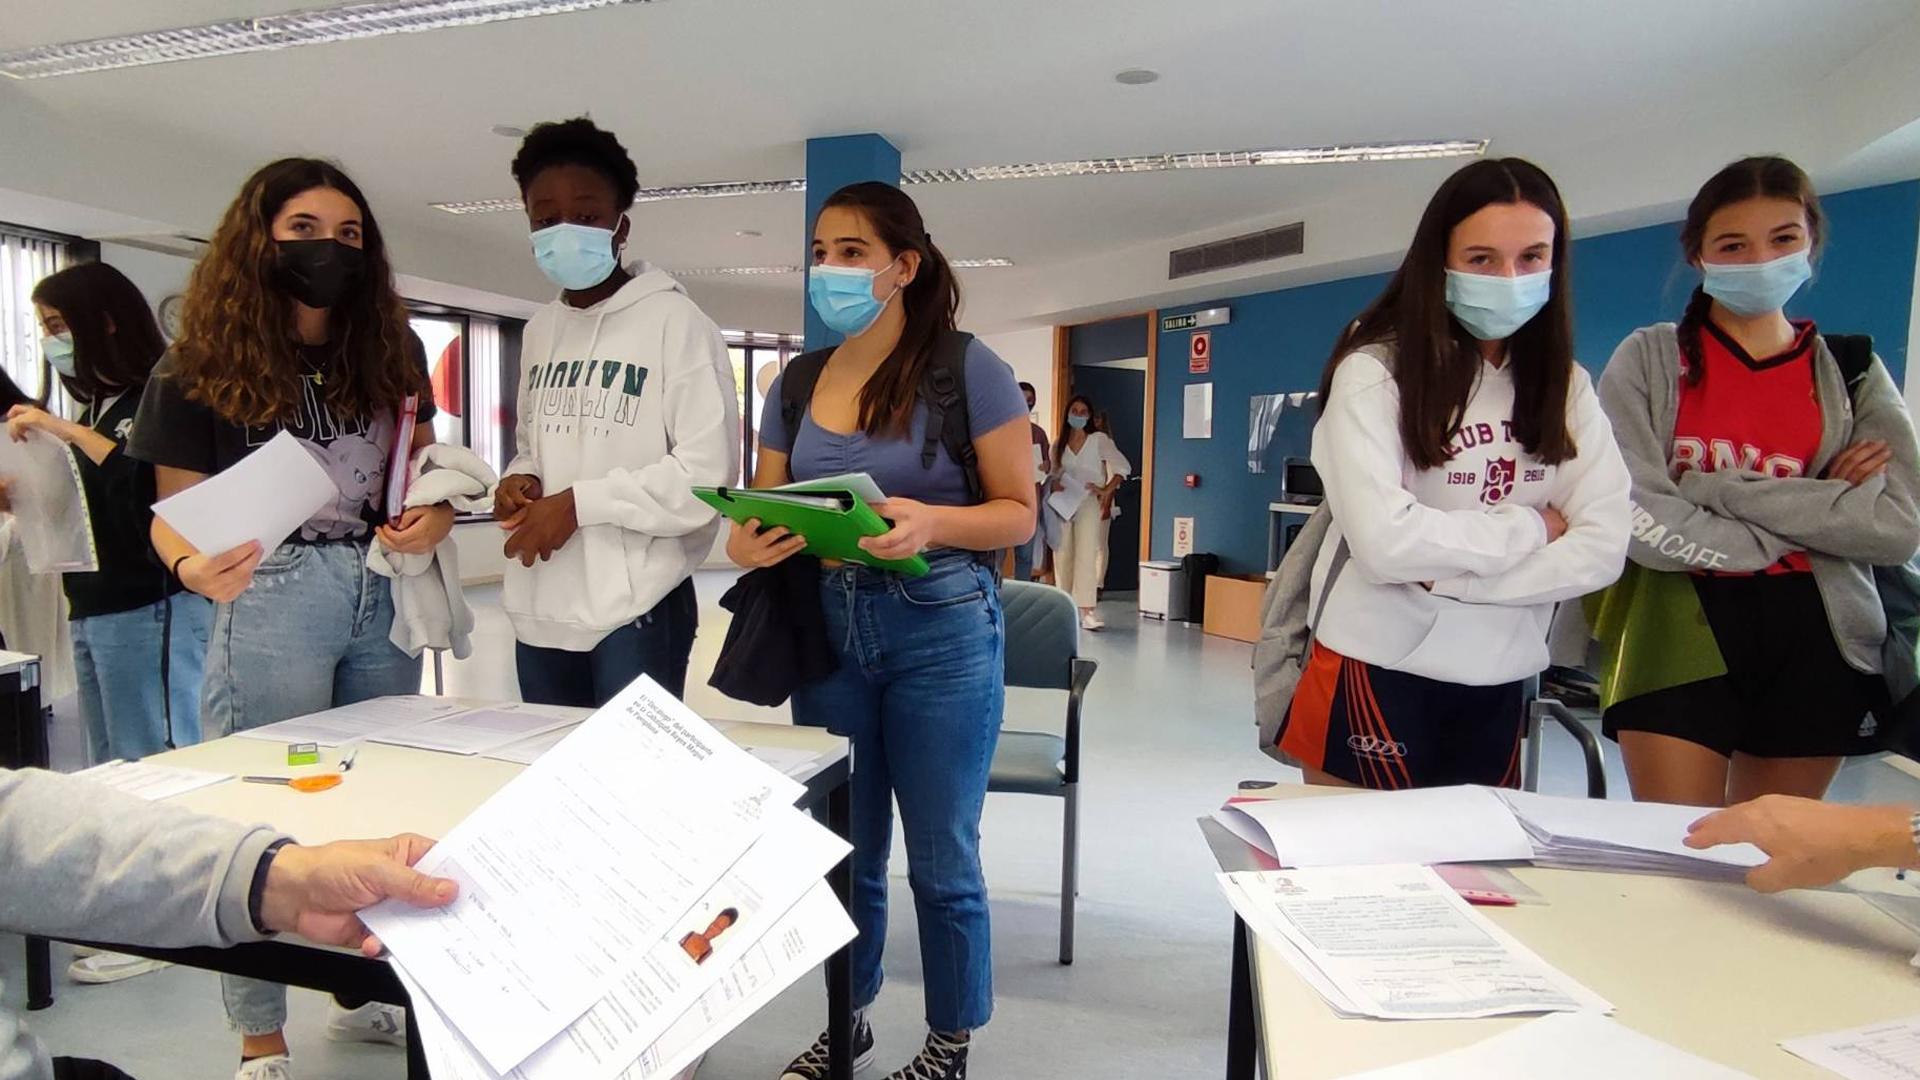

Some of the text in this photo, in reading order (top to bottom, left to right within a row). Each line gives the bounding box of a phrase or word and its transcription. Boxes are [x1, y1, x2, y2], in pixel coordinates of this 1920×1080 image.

[1165, 318, 1187, 329] SALIDA
[1441, 423, 1494, 457] LUB
[1447, 471, 1476, 485] 1918
